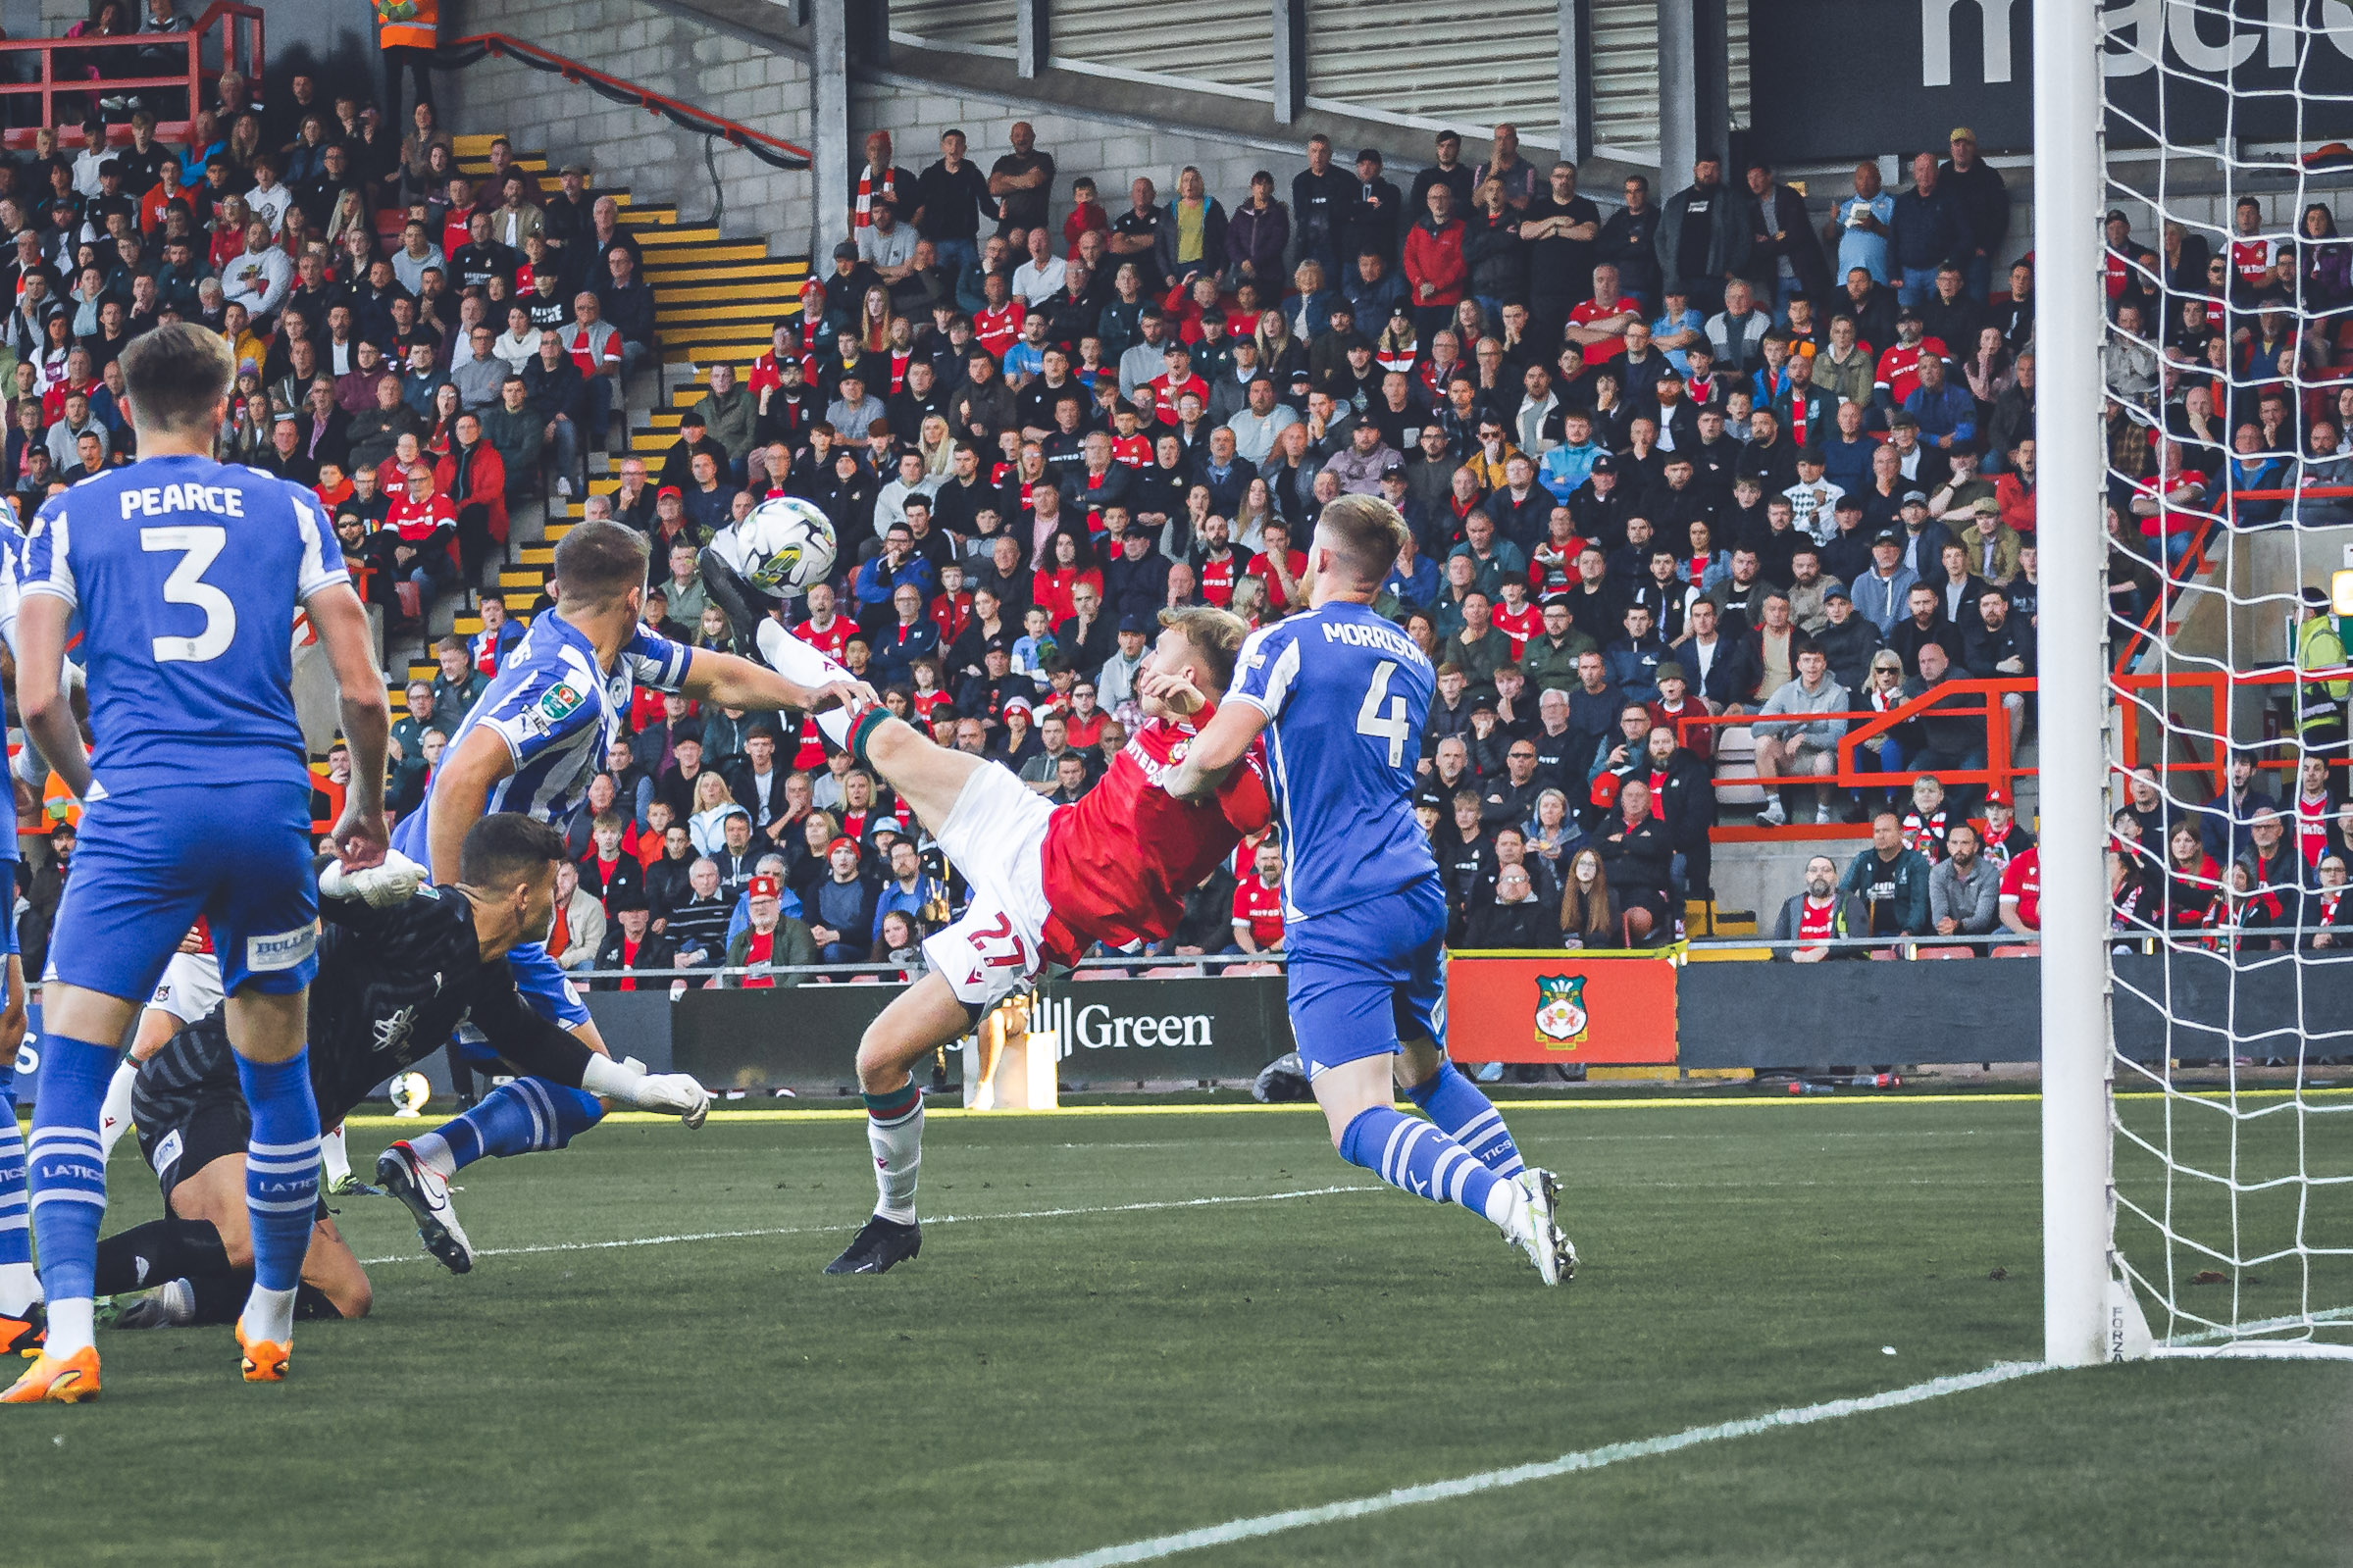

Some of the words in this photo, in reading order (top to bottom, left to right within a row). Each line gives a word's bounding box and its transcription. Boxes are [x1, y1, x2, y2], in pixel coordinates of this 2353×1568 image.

[120, 482, 244, 520] PEARCE
[139, 526, 237, 663] 3
[1321, 622, 1425, 667] MORRISON
[1356, 660, 1409, 768] 4
[967, 911, 1027, 968] 27
[1076, 1003, 1212, 1048] Green
[1480, 1138, 1512, 1164] TICS
